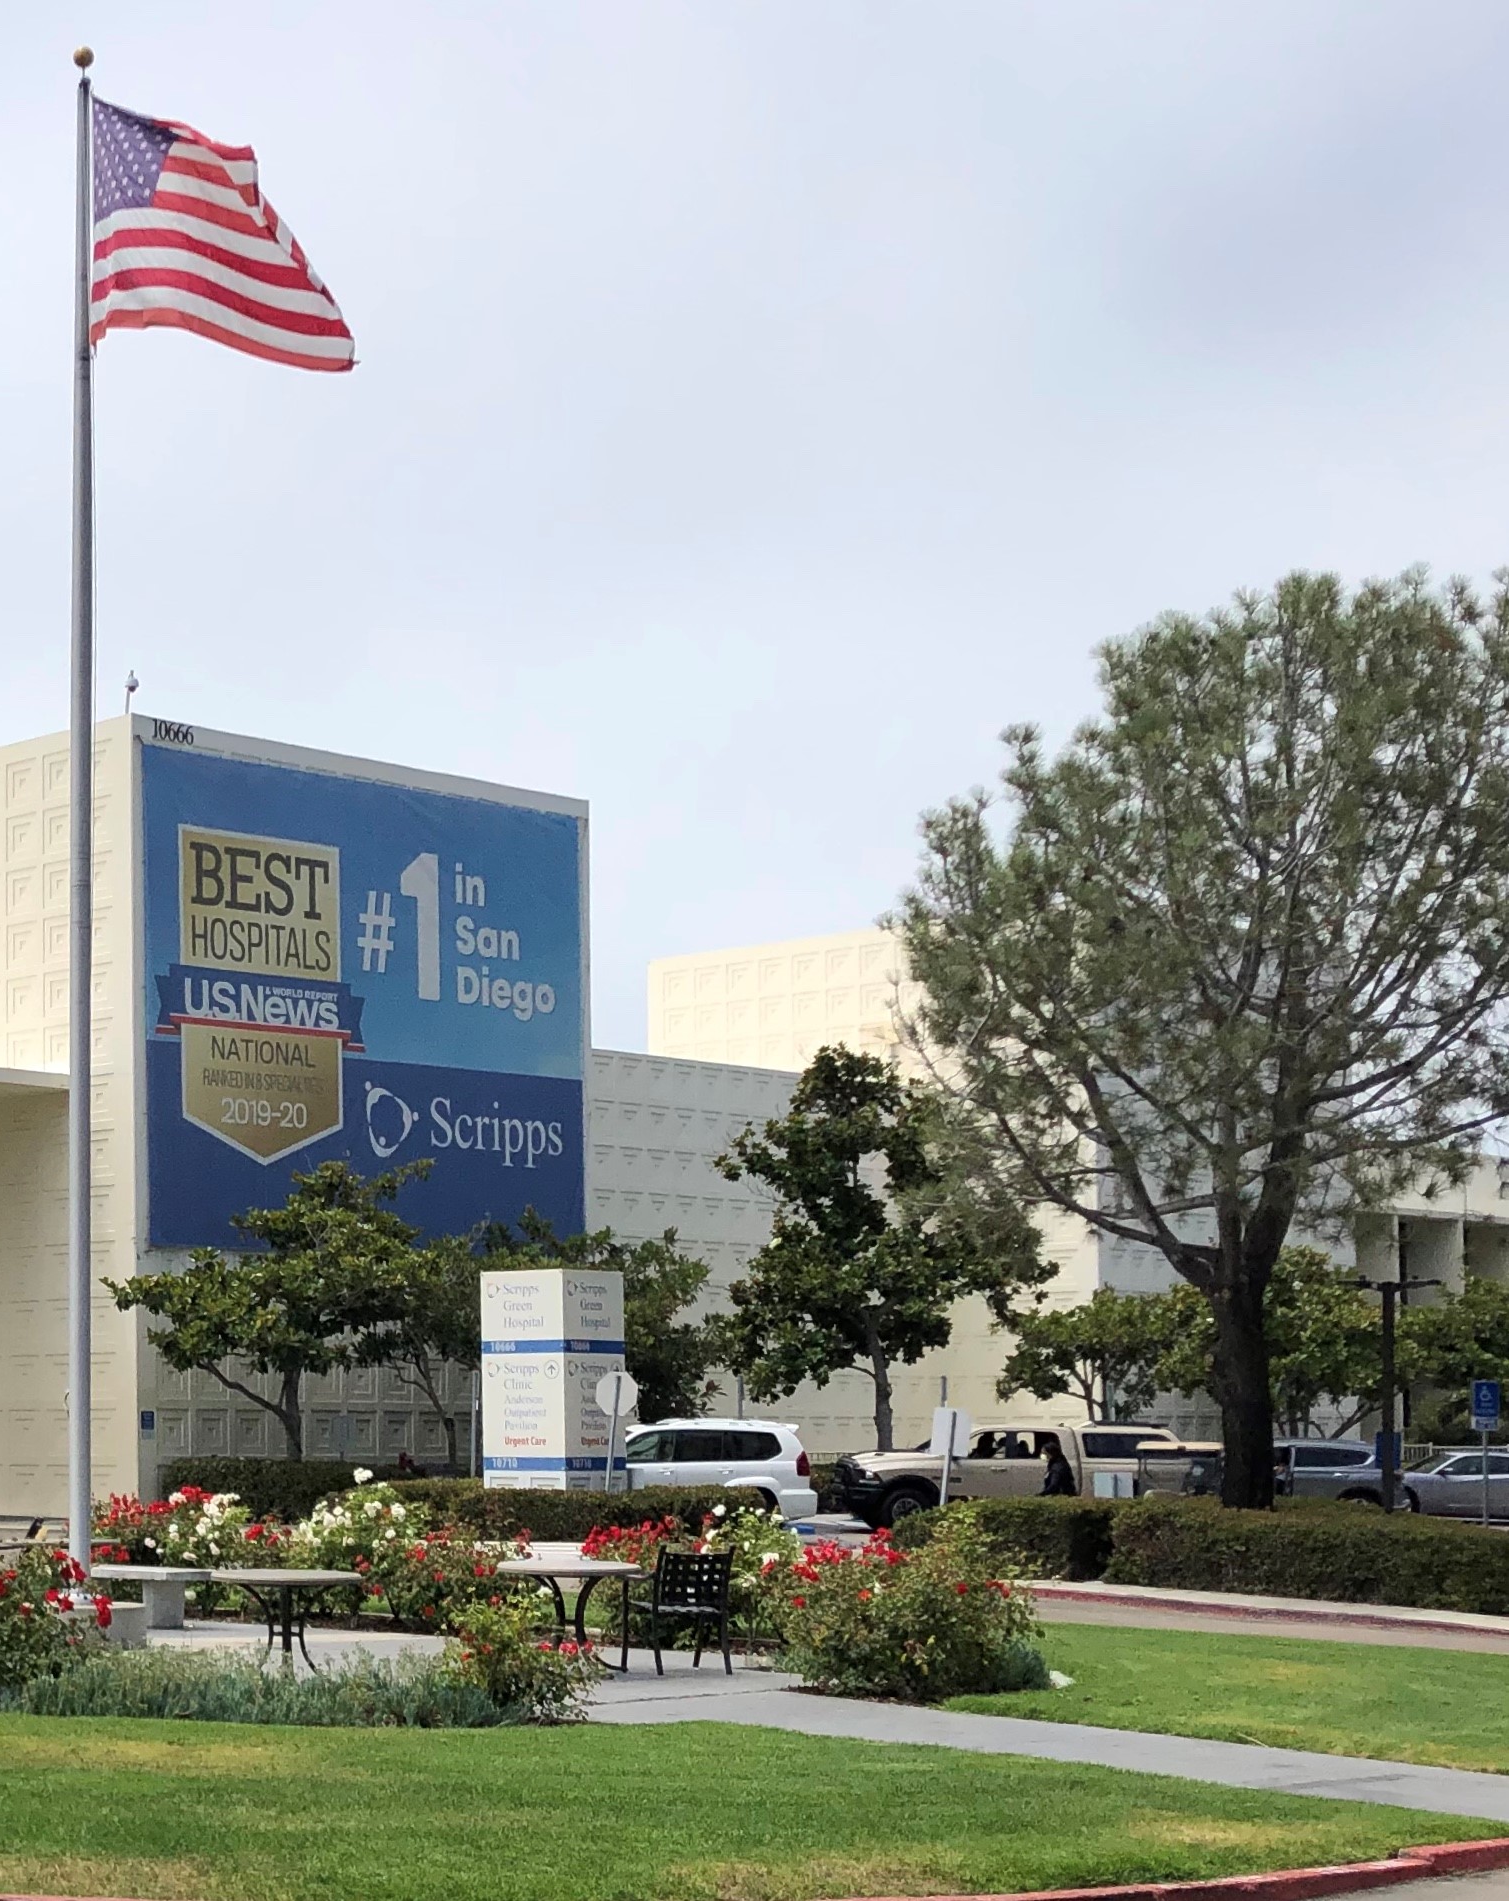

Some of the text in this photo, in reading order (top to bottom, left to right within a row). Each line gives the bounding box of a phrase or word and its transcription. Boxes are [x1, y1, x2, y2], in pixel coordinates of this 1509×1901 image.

[151, 718, 195, 746] 10666
[189, 841, 330, 921] BEST
[455, 862, 486, 907] in
[191, 914, 332, 973] HOSPITALS
[455, 915, 521, 961] San
[265, 986, 338, 1002] & WORLD REPORT
[456, 965, 557, 1022] Diego
[211, 1034, 317, 1069] NATIONAL
[202, 1067, 243, 1089] RANKED
[244, 1071, 255, 1090] IN
[220, 1097, 308, 1129] 2019-20
[430, 1096, 564, 1169] Scripps
[503, 1283, 540, 1297] Scripps
[503, 1300, 533, 1312] Green
[503, 1315, 544, 1331] Hospital
[503, 1361, 540, 1376] Scripps
[503, 1378, 533, 1390] Clinic
[504, 1436, 547, 1447] Urgent Care
[492, 1457, 518, 1468] 10710
